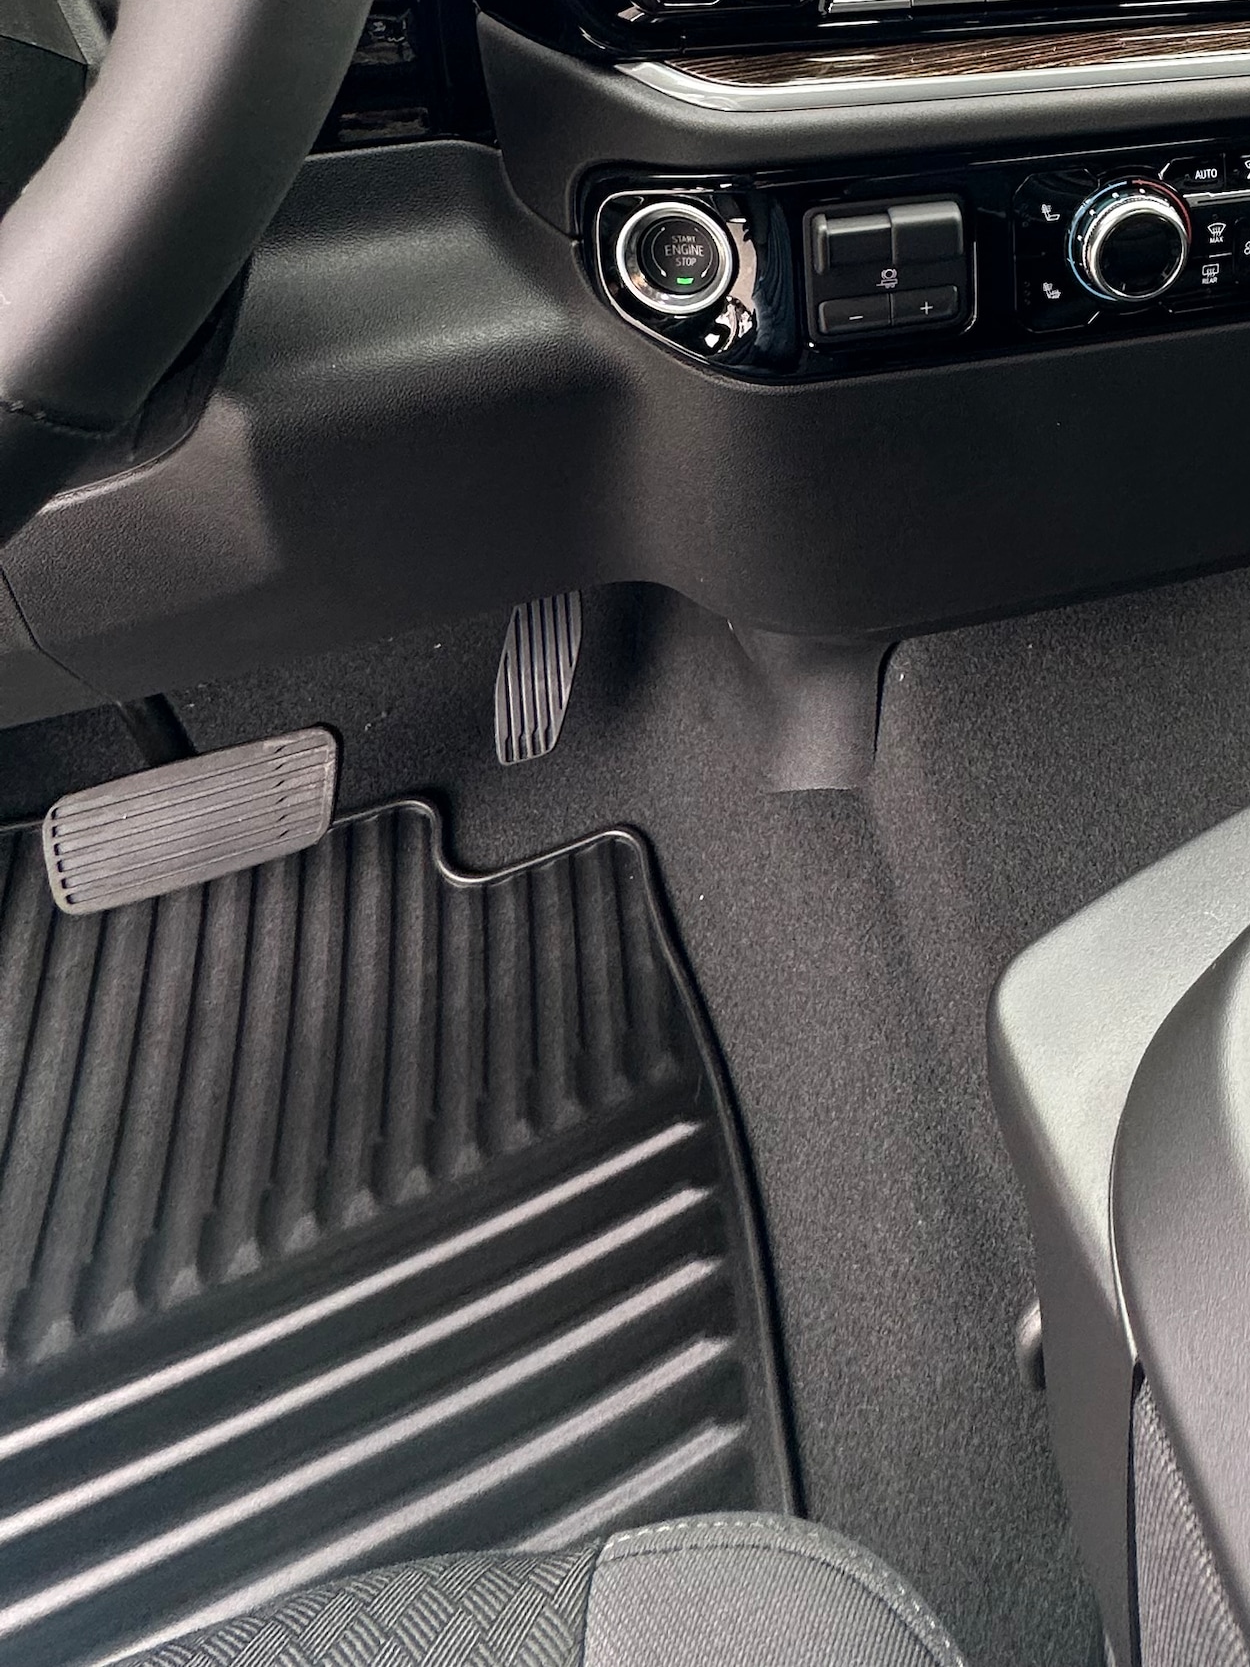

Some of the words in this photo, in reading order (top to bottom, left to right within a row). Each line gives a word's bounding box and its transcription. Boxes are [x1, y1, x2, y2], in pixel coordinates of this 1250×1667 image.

[1195, 168, 1218, 180] AUTO
[671, 235, 696, 244] START
[1209, 235, 1224, 244] MAX
[664, 244, 704, 257] ENGINE
[675, 256, 697, 267] STOP
